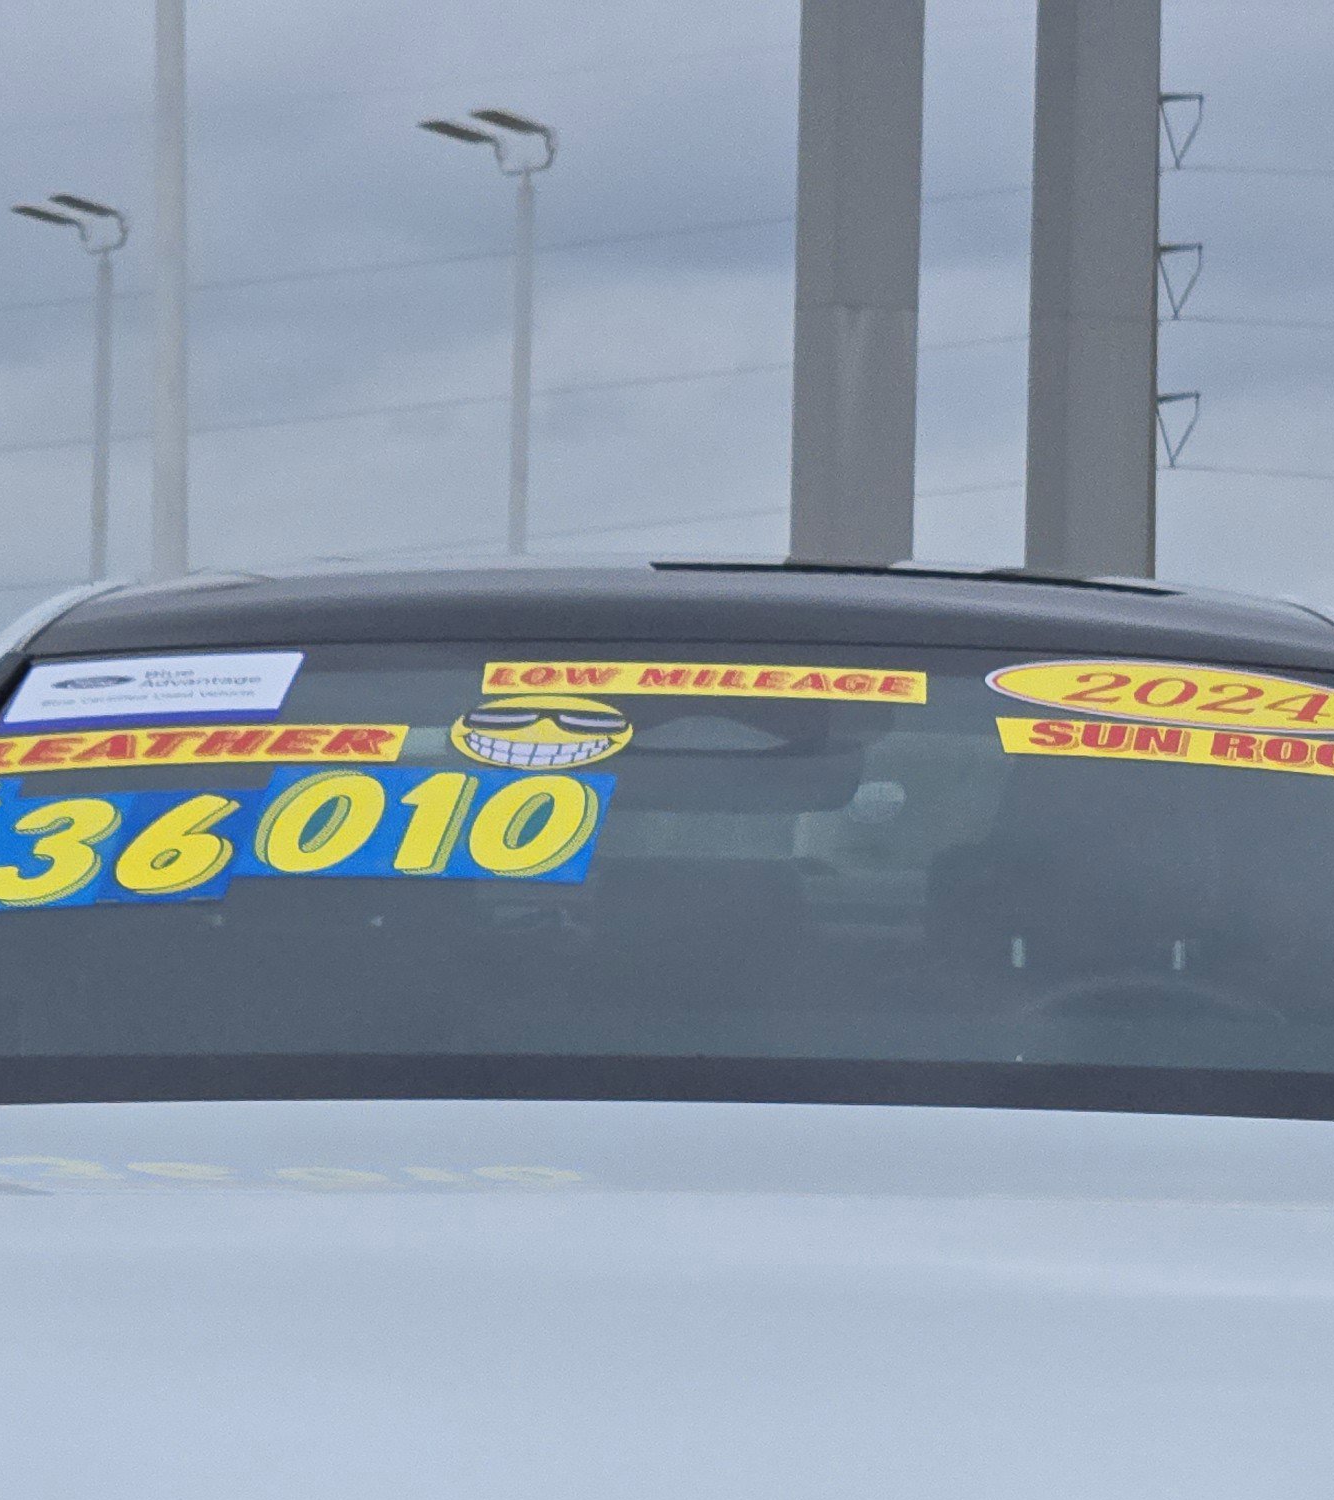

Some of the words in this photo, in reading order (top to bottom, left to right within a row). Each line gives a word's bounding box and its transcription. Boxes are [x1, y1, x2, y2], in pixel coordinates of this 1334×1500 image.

[487, 666, 621, 688] LOW
[637, 667, 917, 696] MILEAGE
[1062, 673, 1333, 724] 2024
[1028, 720, 1192, 758] SUN
